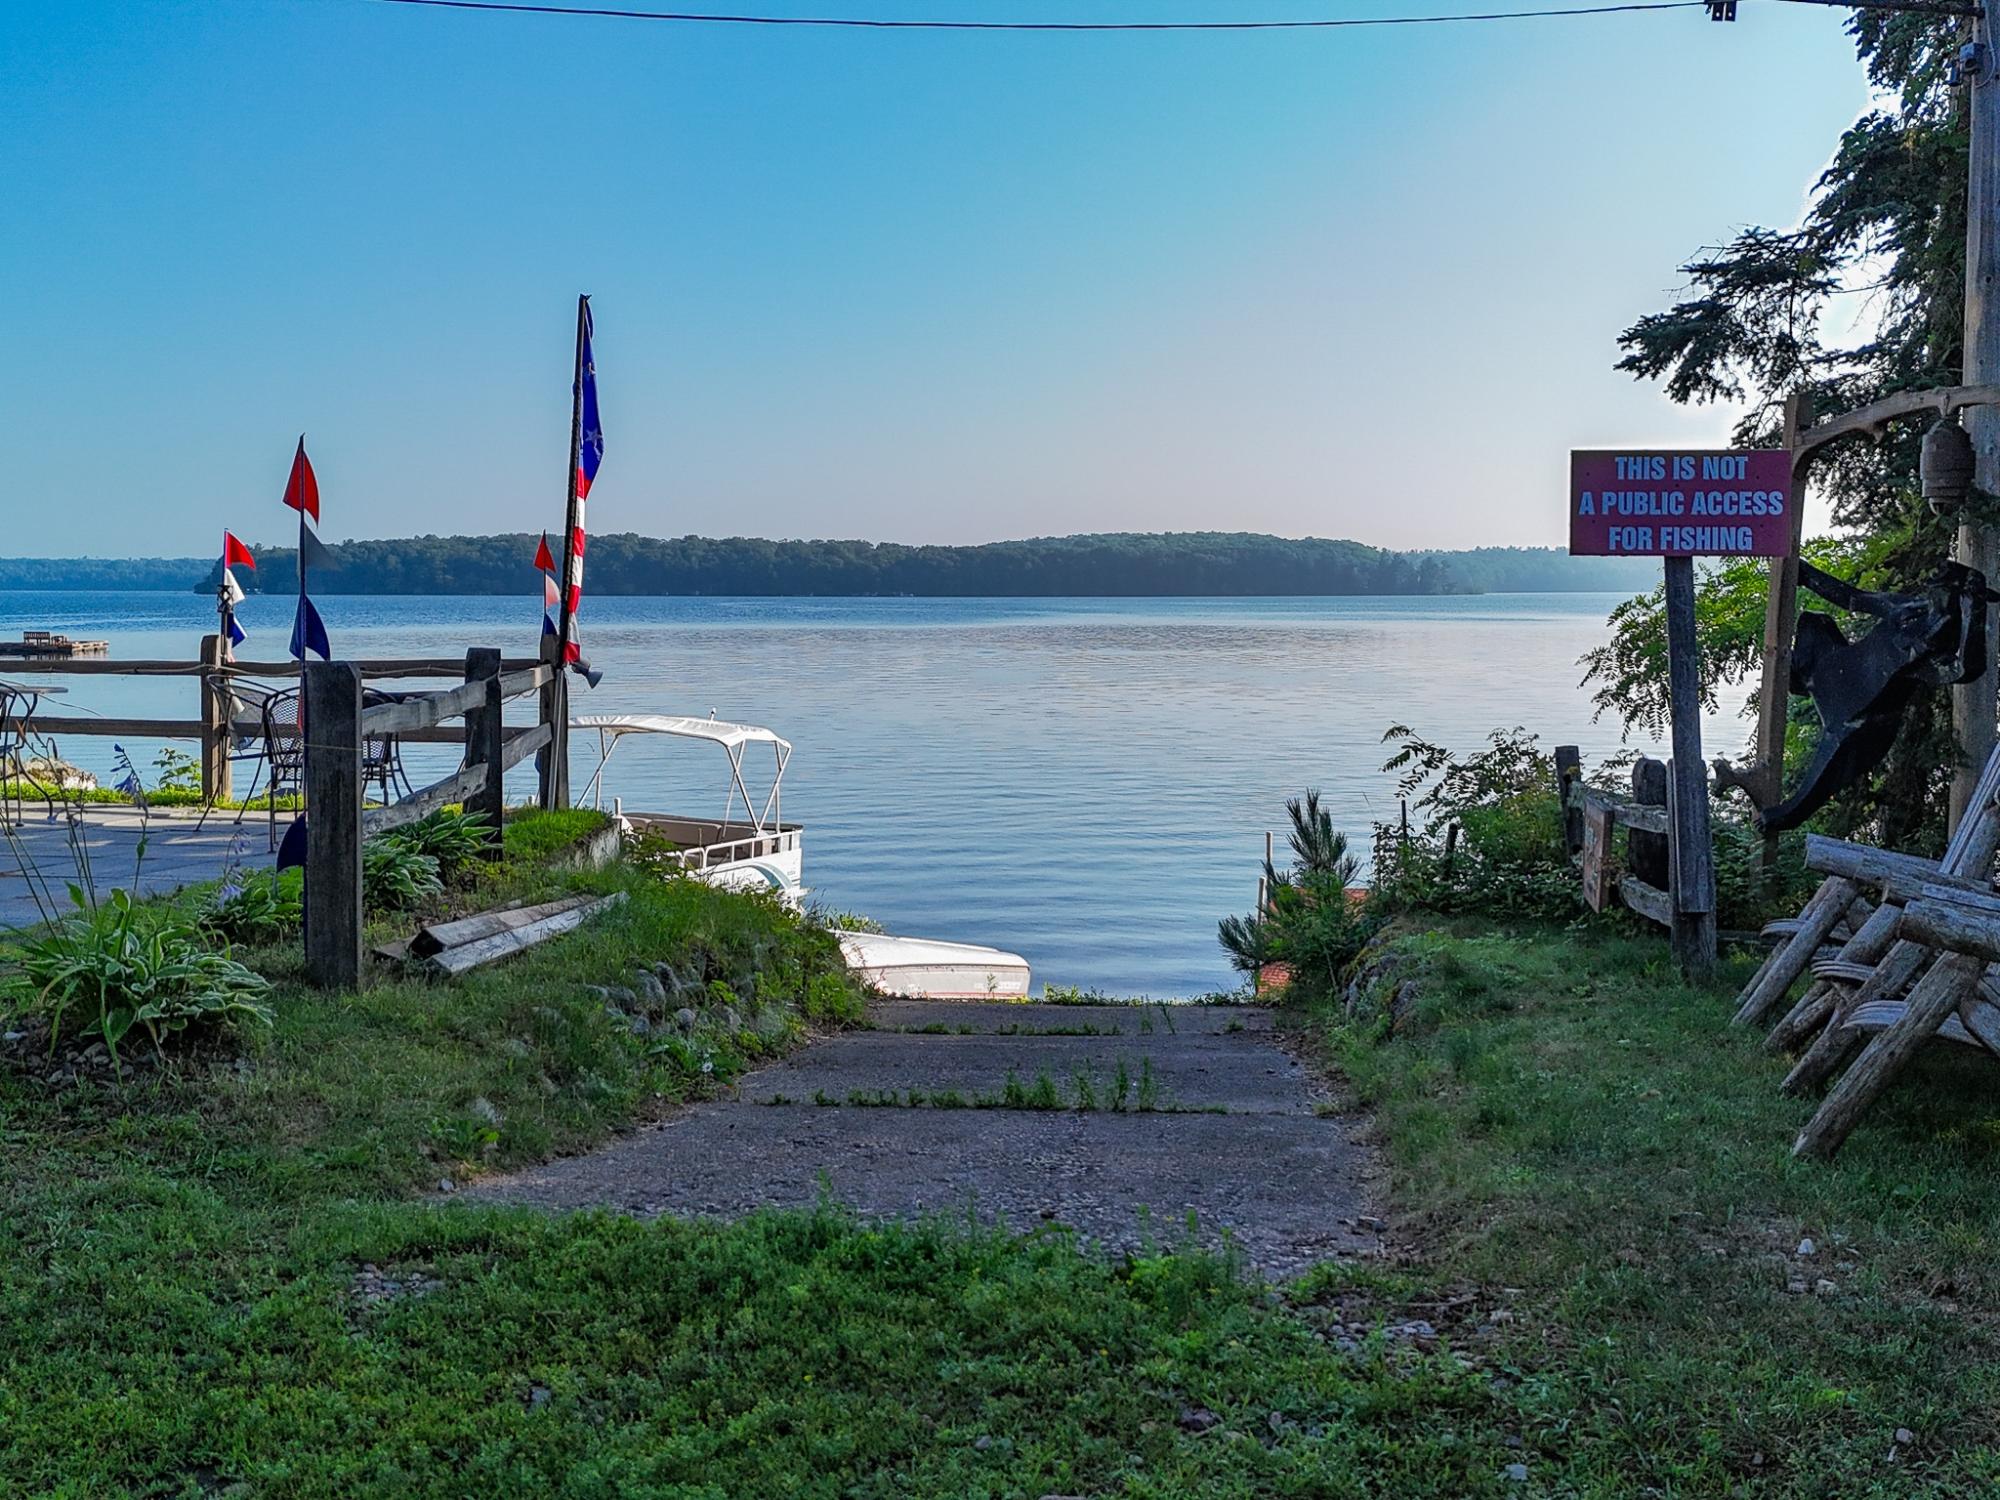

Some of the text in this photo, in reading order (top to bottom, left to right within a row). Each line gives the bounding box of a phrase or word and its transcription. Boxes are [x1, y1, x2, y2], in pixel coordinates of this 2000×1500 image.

[1615, 456, 1748, 480] THIS IS NOT
[1578, 491, 1783, 516] A PUBLIC ACCESS
[1608, 526, 1753, 551] FOR FISHING
